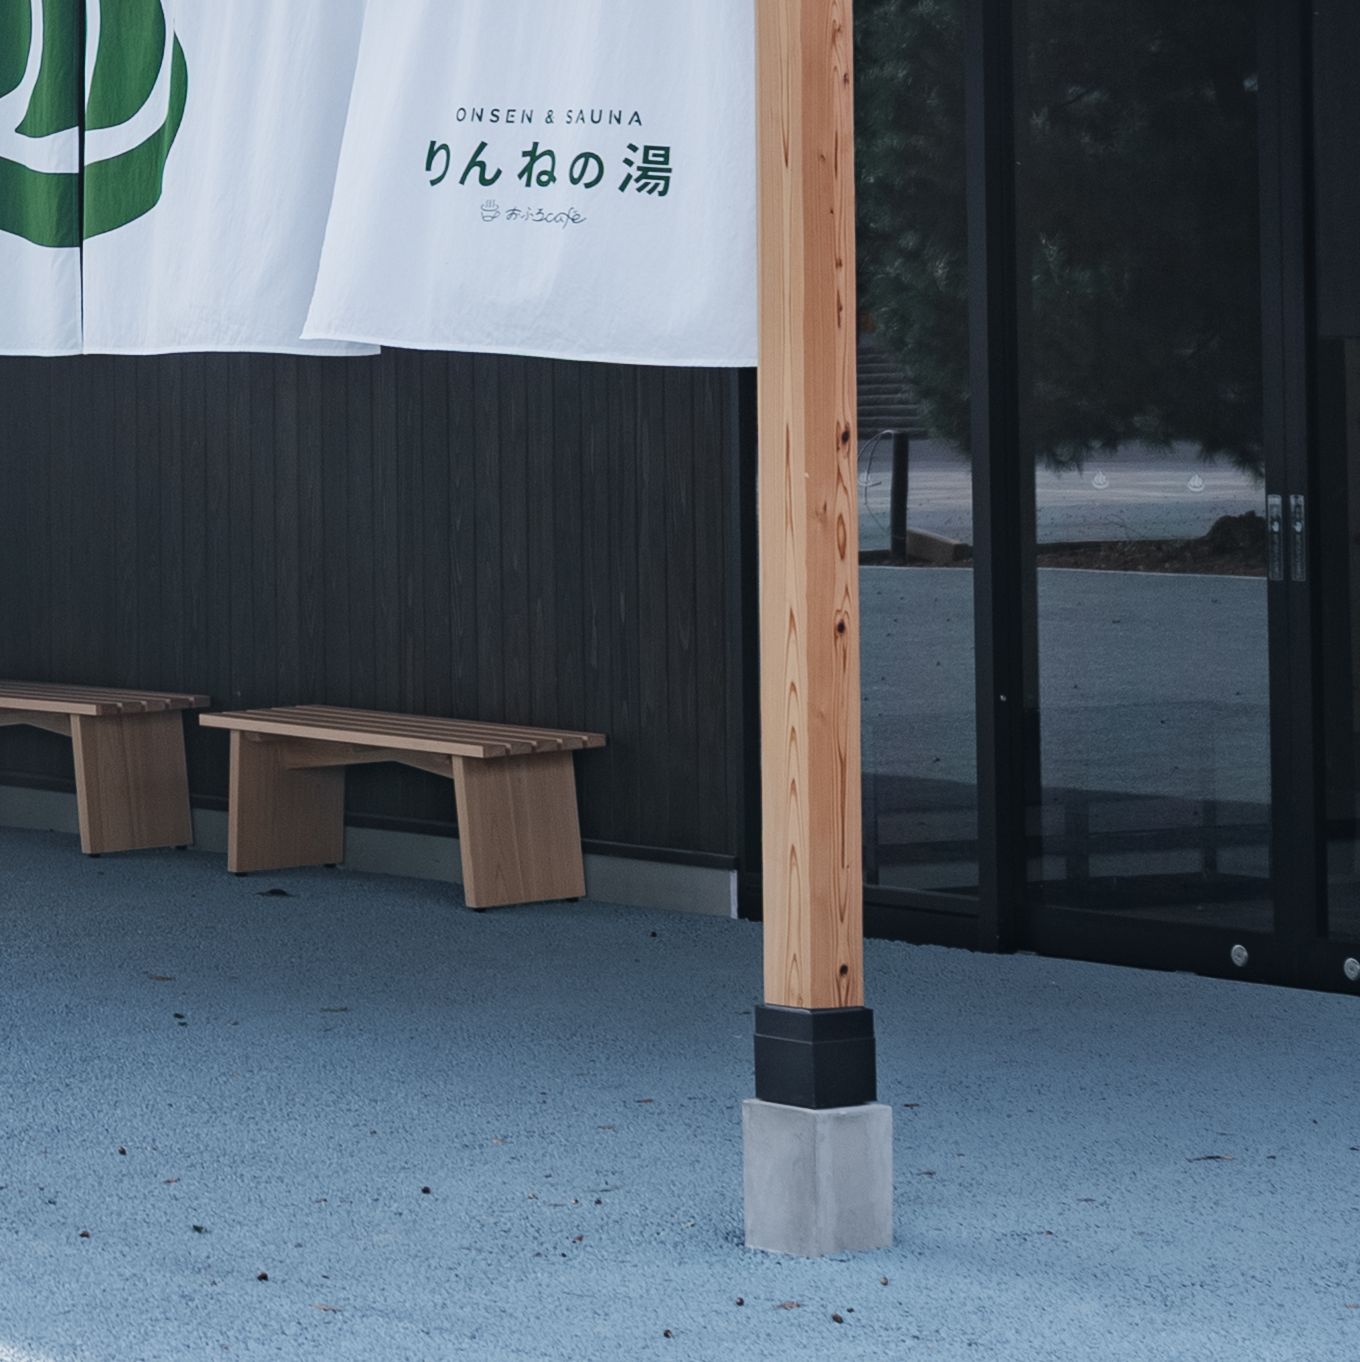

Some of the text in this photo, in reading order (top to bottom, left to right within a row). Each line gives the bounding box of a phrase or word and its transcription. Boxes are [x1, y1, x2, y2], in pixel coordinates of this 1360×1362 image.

[455, 107, 643, 126] ONSEN & SAUNA
[424, 139, 673, 198] りんねの湯
